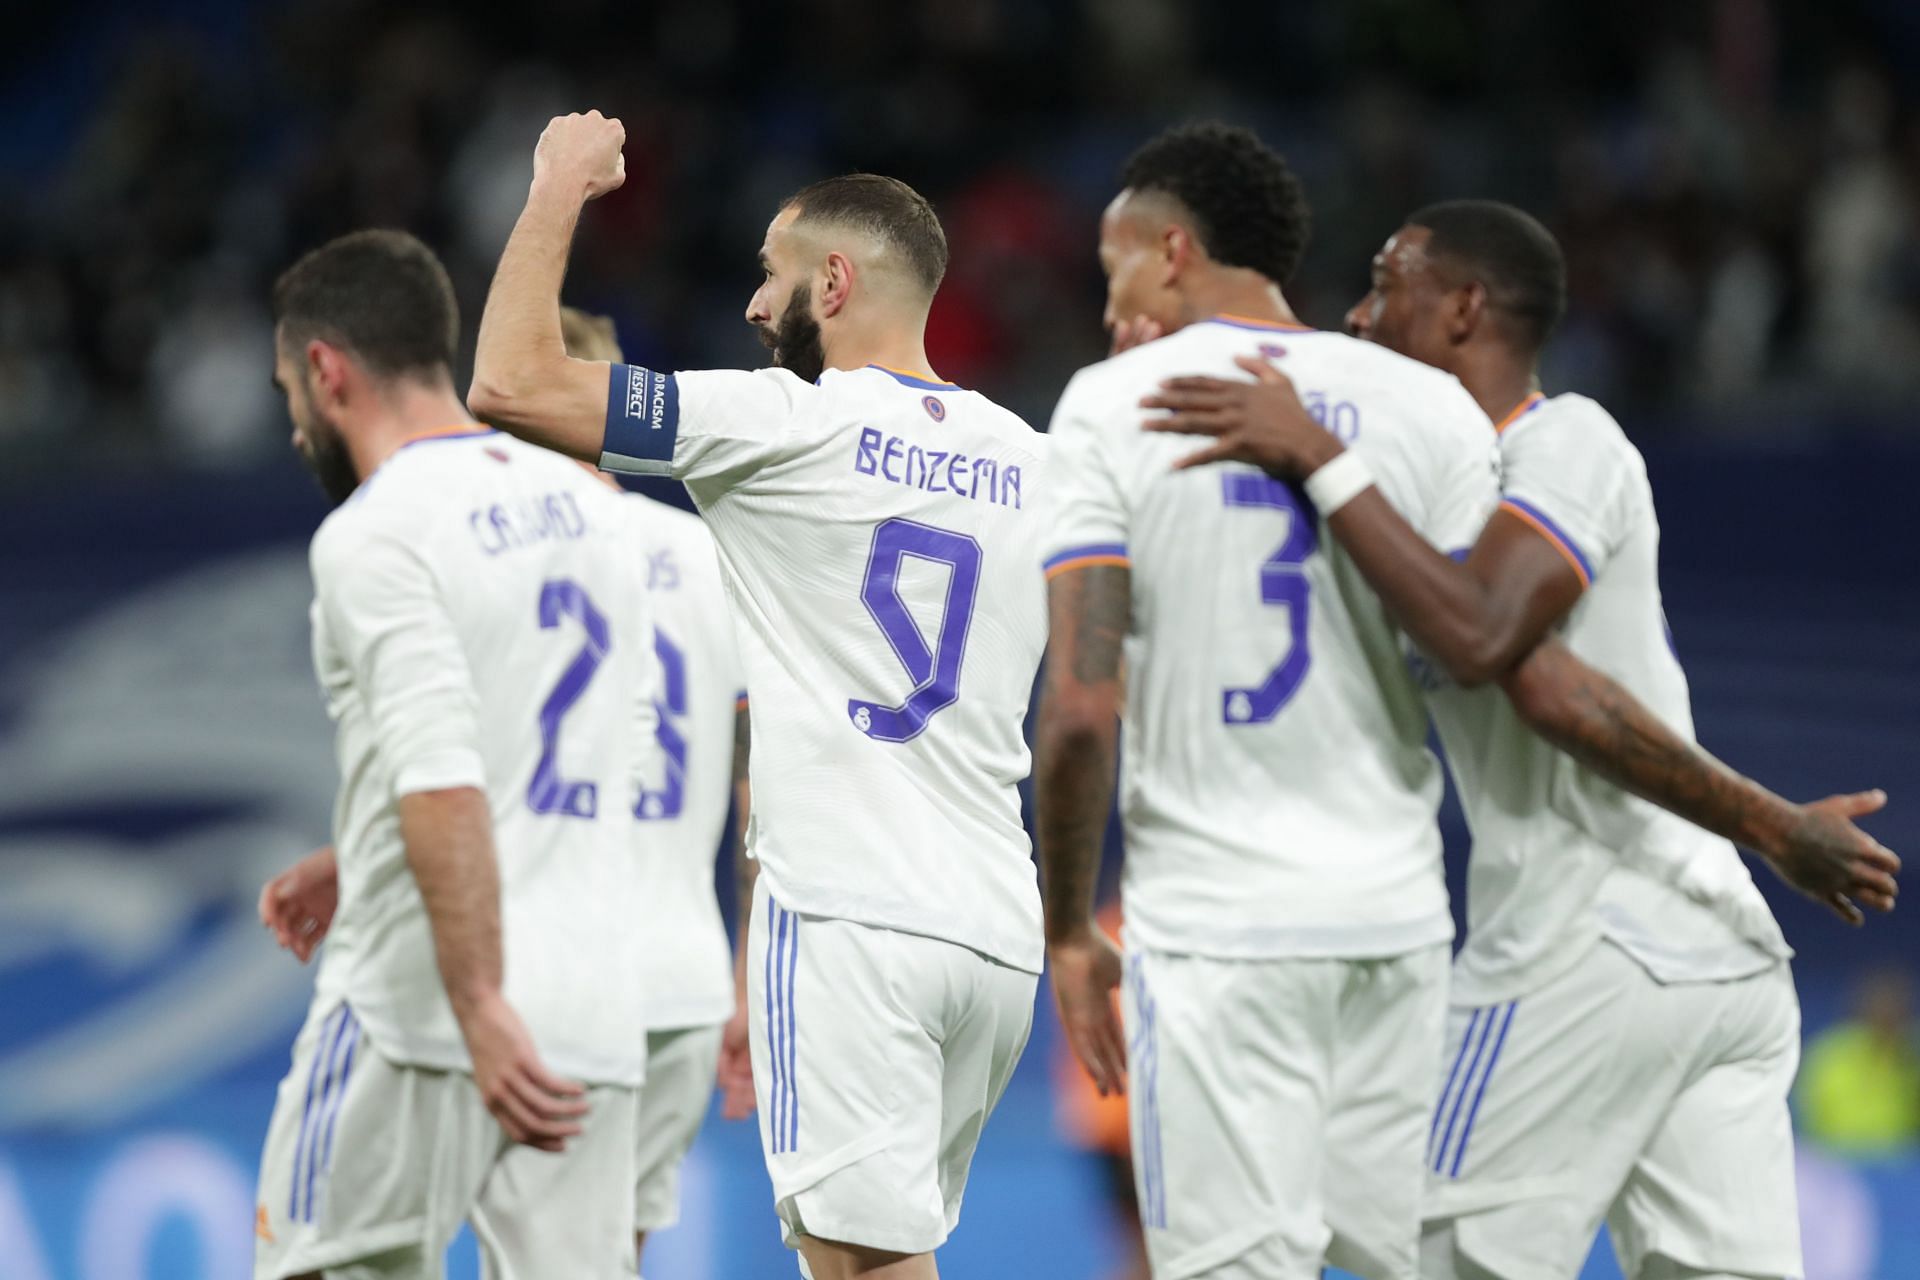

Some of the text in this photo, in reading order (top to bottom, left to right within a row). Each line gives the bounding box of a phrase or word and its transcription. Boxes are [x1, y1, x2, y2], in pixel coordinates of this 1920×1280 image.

[629, 370, 644, 419] RESPECT
[651, 384, 666, 430] RACISM
[855, 426, 1021, 510] BENZEMA
[848, 517, 983, 744] 9
[1221, 473, 1319, 725] 3
[527, 577, 610, 820] 2
